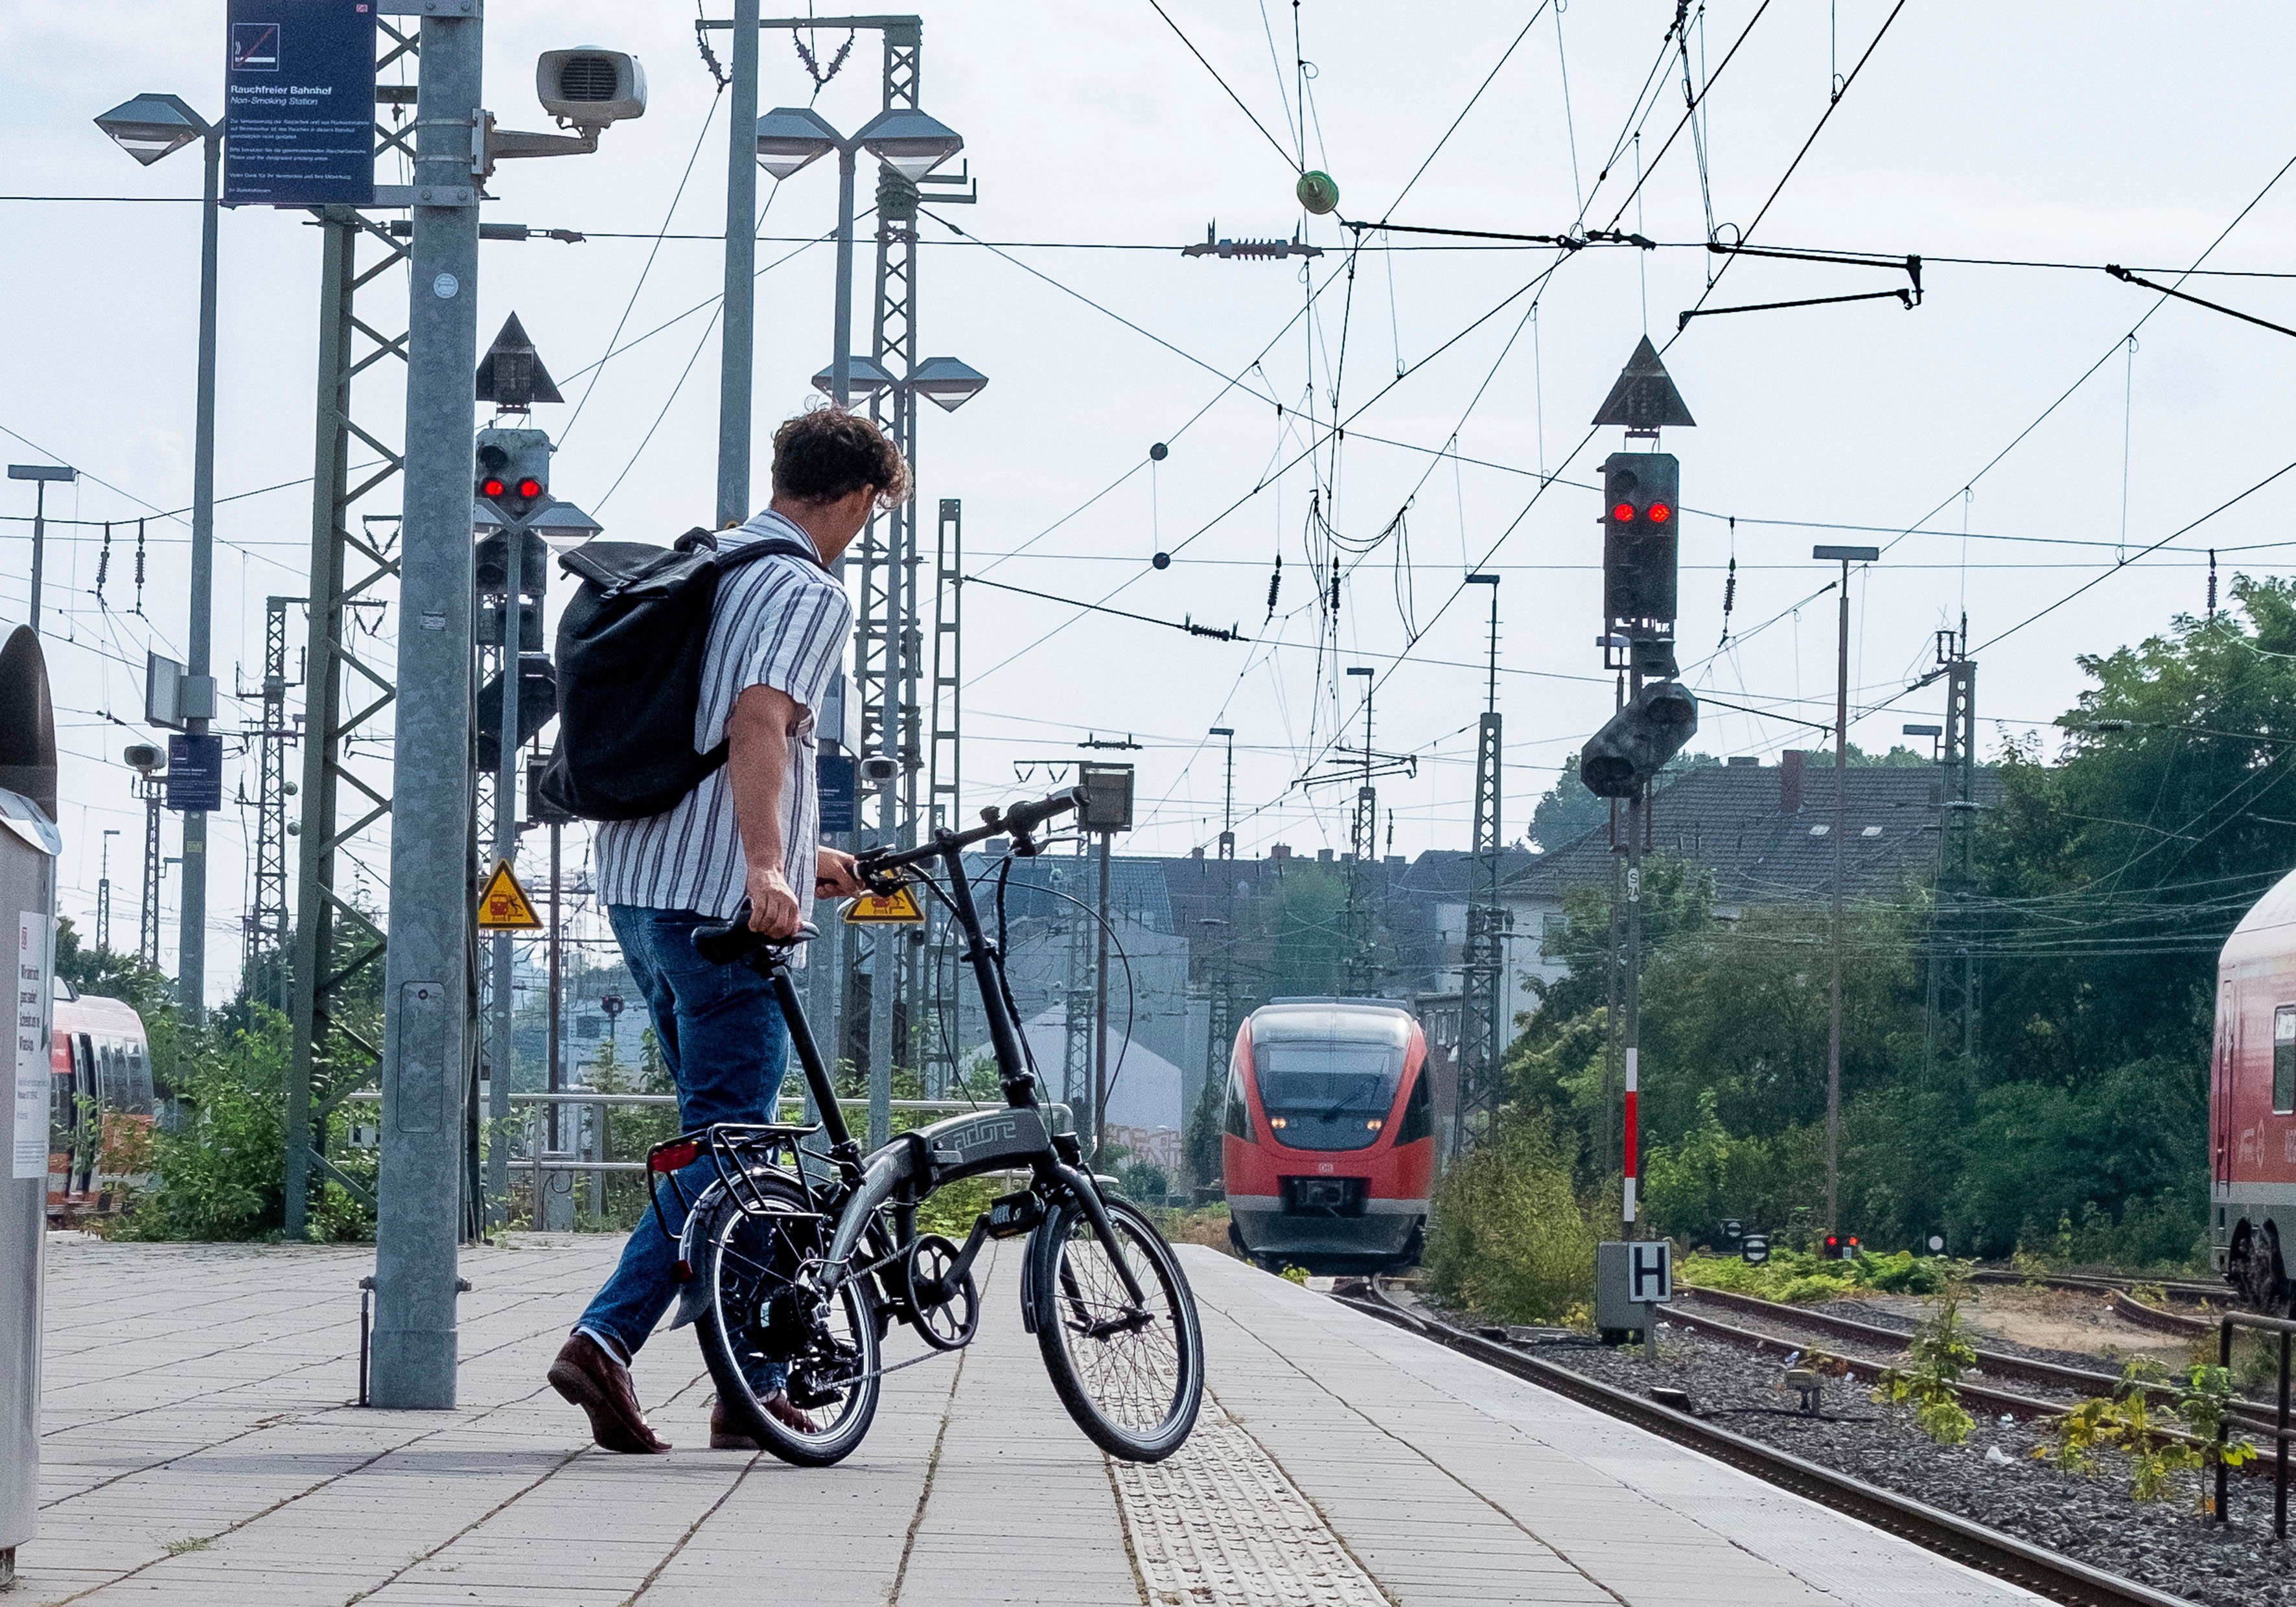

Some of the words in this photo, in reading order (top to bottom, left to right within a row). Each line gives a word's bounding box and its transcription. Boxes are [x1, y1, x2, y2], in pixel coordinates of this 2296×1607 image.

[230, 85, 288, 95] Rauchfreier
[290, 86, 332, 95] Bahnhof
[230, 97, 286, 106] Non-Smoking
[288, 97, 318, 106] Station
[1630, 872, 1638, 883] S
[1319, 1163, 1333, 1172] DB
[1634, 1246, 1666, 1297] H
